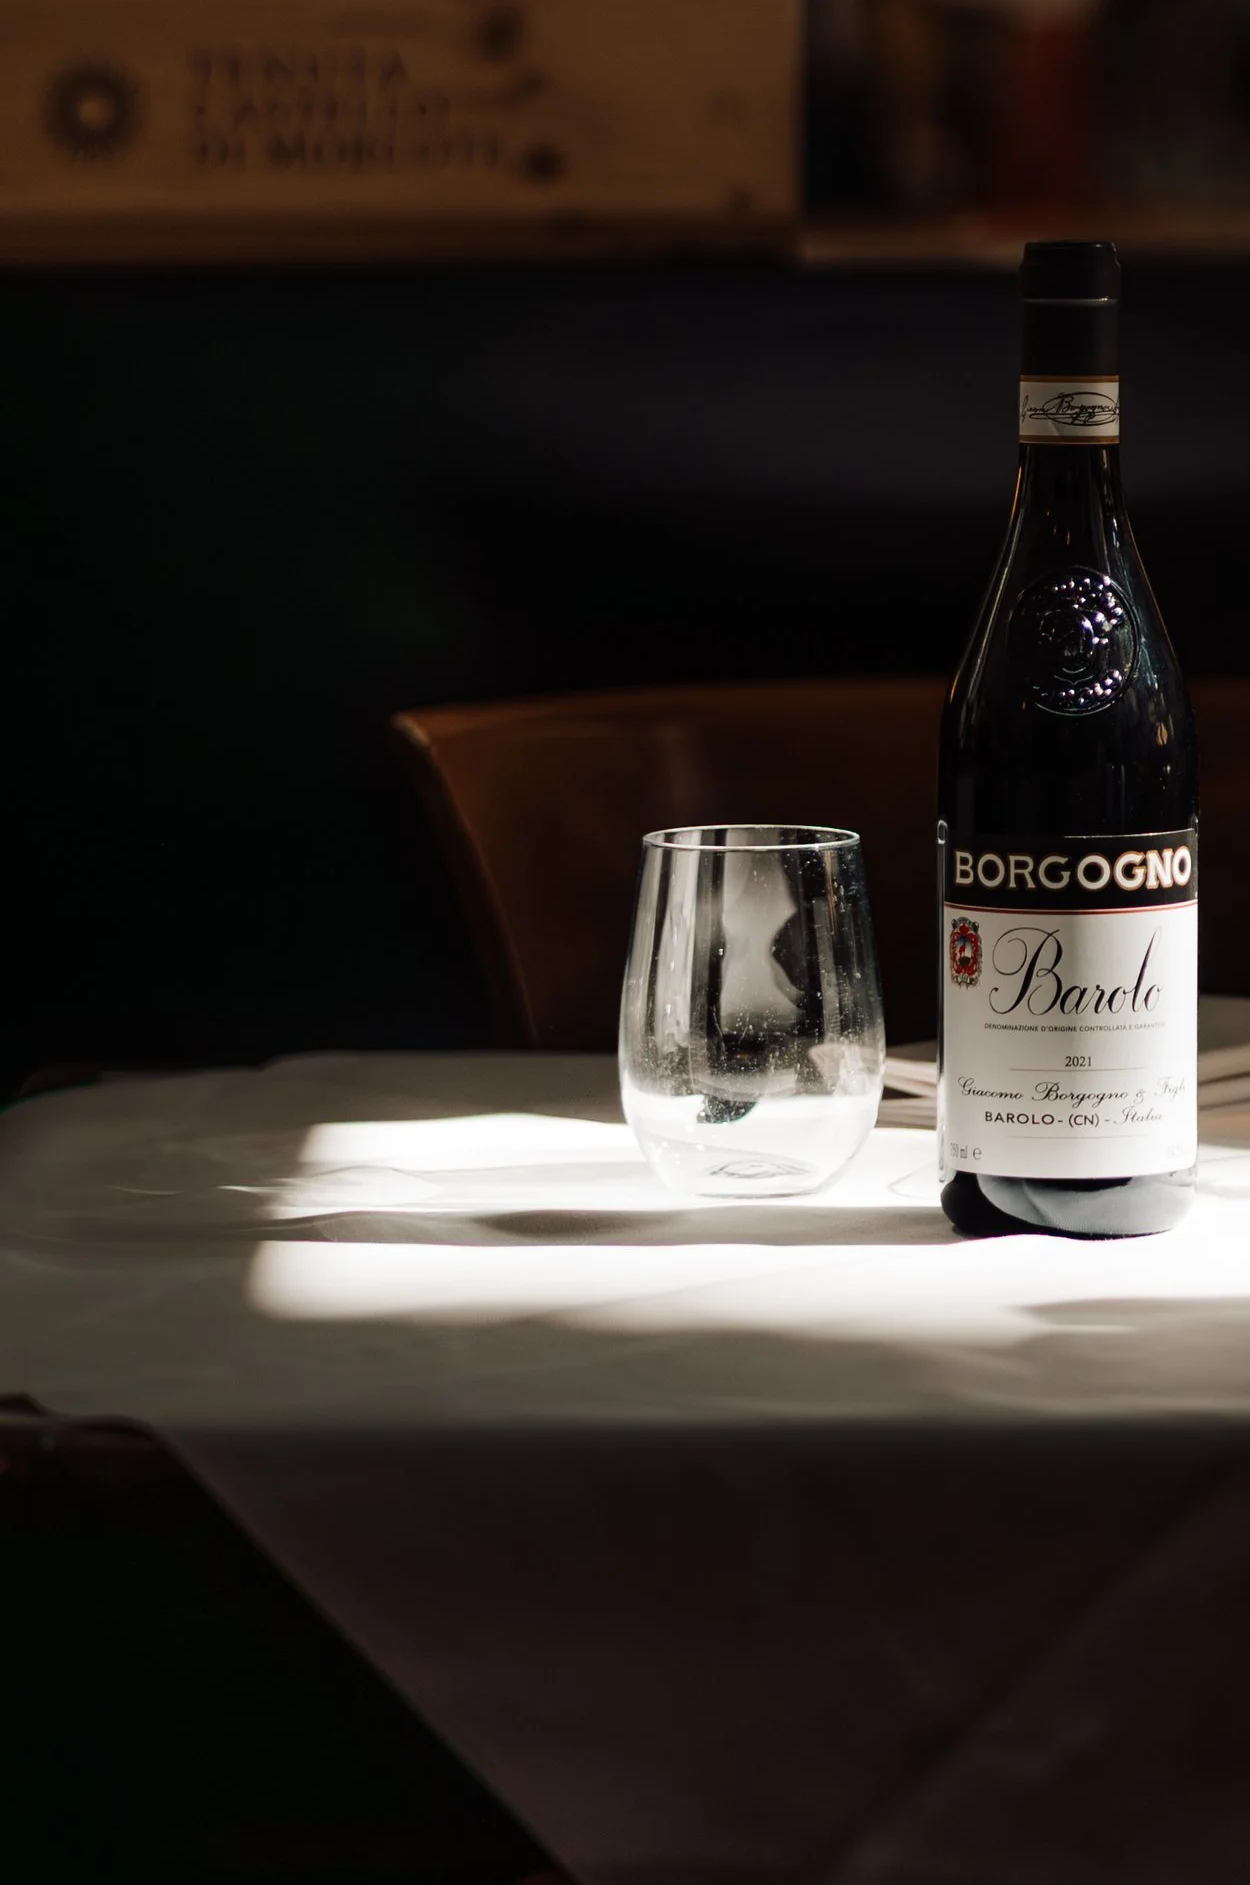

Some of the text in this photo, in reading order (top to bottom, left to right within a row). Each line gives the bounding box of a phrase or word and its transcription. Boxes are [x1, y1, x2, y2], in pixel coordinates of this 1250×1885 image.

[955, 845, 1192, 891] BORGOGNO
[989, 926, 1165, 1016] Barolo
[984, 1022, 1039, 1033] DENOMINAZIONE
[1041, 1025, 1077, 1033] D'ORIGINE
[1079, 1024, 1127, 1033] CONTROLLATA
[1065, 1055, 1092, 1067] 2021
[958, 1076, 1023, 1100] Giacomo
[1031, 1081, 1128, 1109] Borgogno
[1133, 1088, 1146, 1104] &
[1068, 1113, 1100, 1128] (CN)
